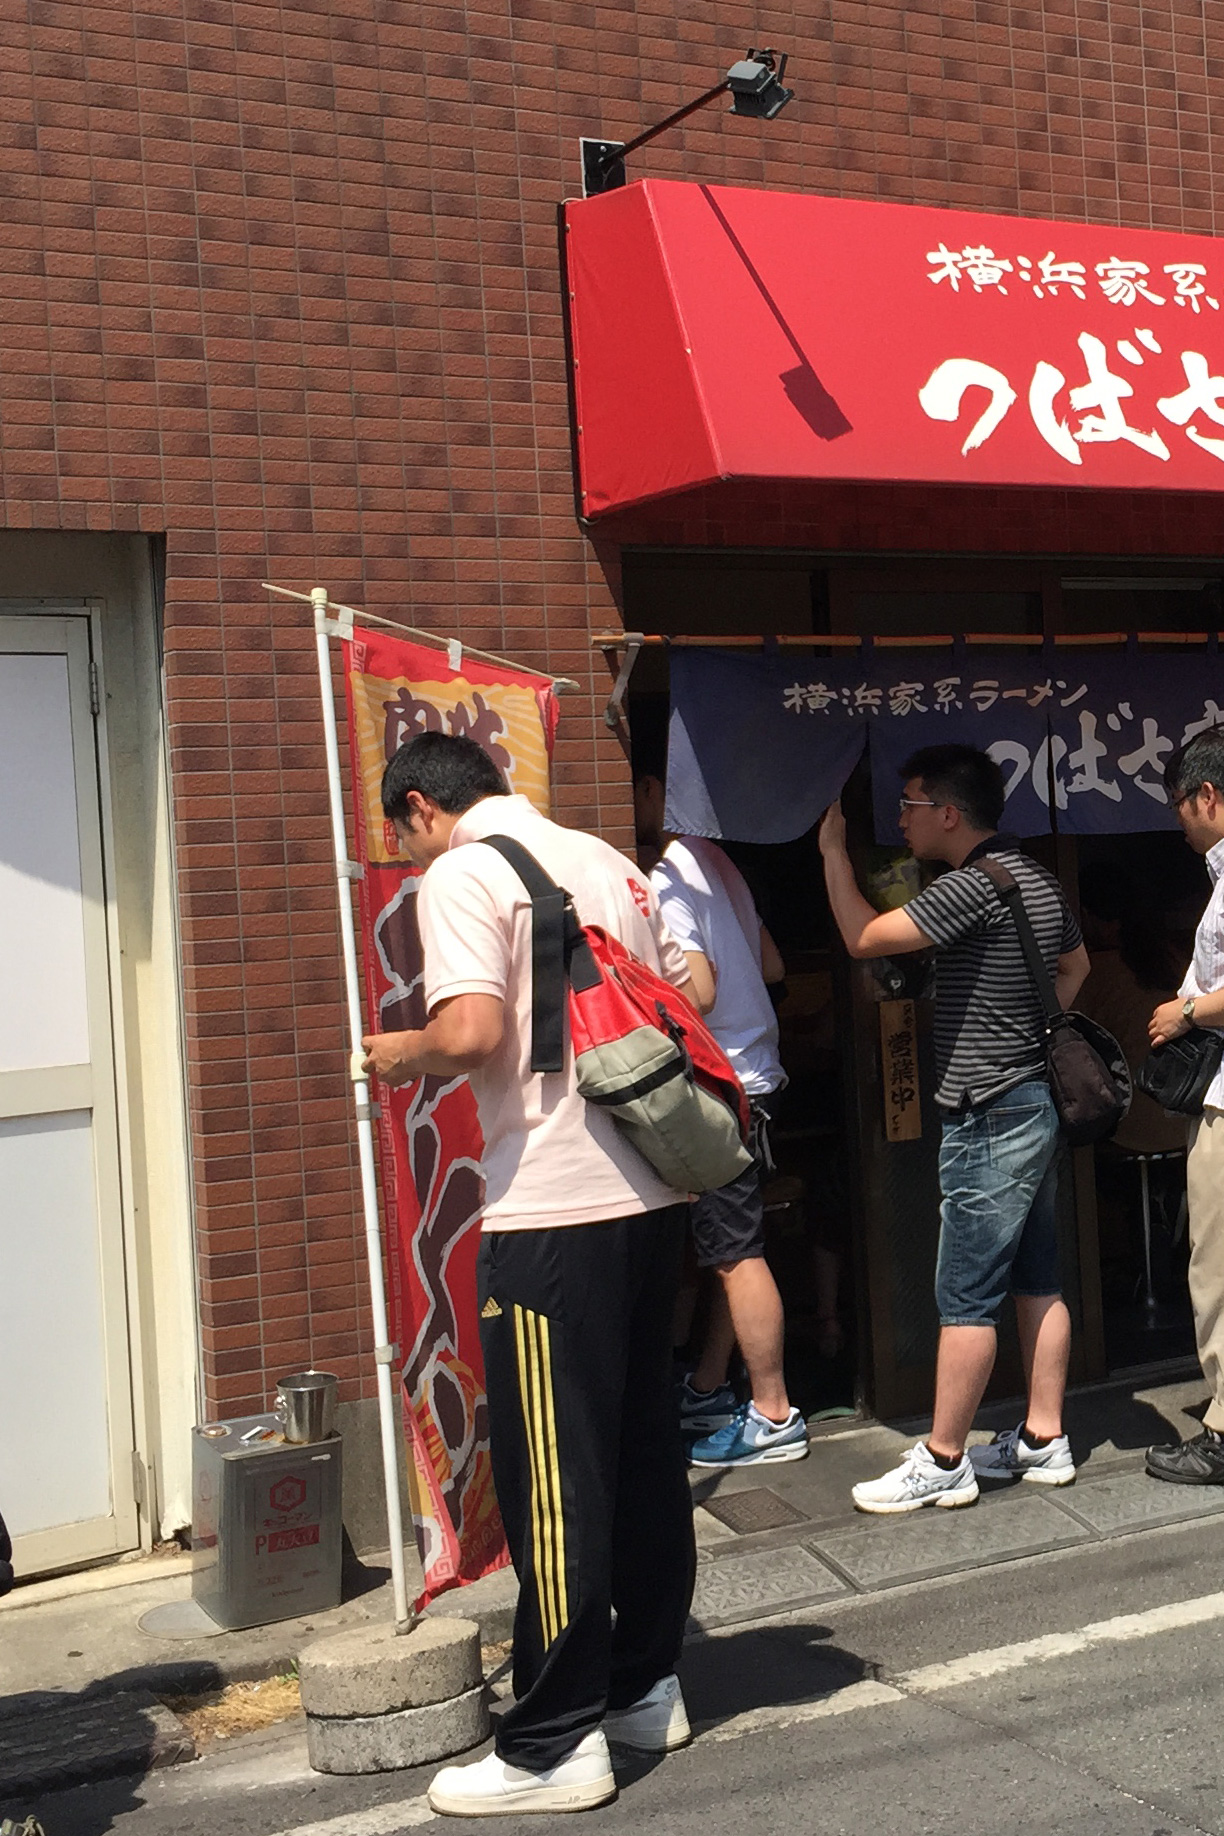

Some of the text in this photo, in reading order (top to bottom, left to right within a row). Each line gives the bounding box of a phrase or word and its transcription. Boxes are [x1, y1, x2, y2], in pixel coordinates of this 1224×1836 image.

[783, 677, 1088, 717] 横浜家系ラーメン
